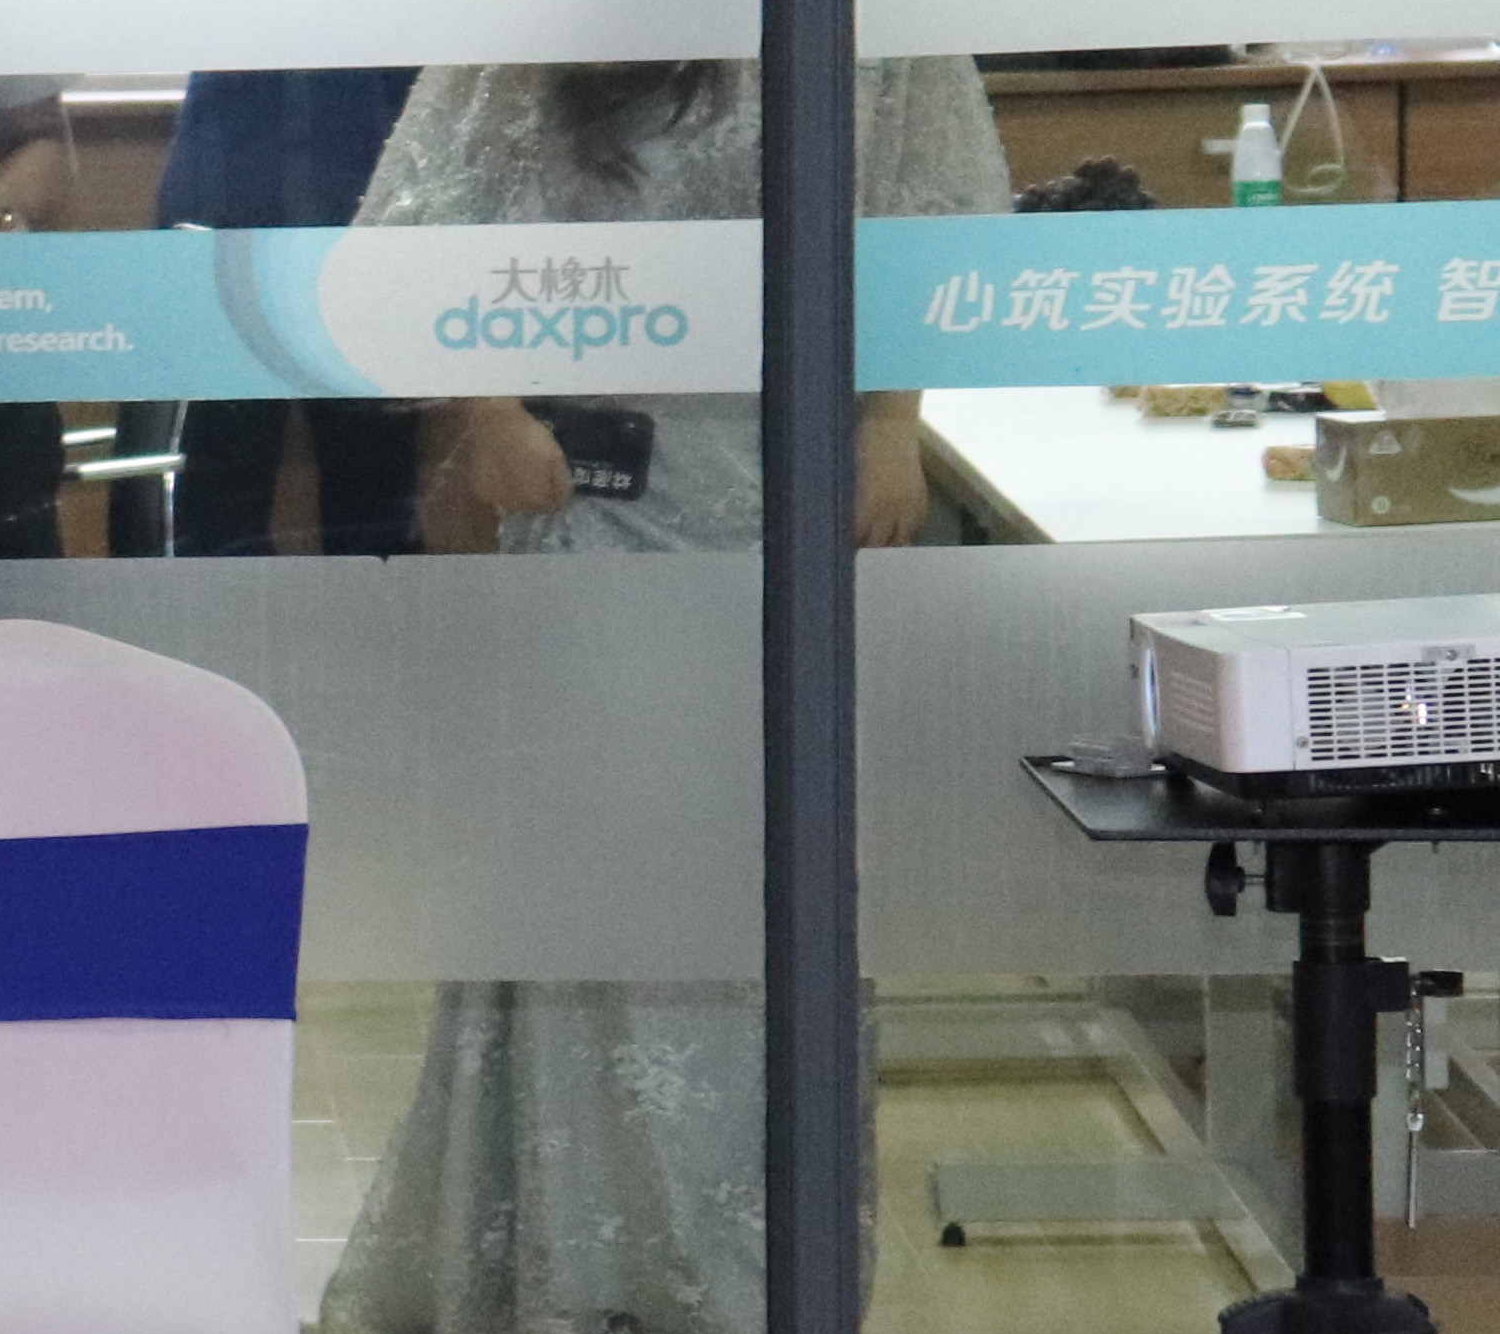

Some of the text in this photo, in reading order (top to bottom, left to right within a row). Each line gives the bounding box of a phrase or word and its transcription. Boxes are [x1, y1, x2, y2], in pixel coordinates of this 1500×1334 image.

[434, 297, 689, 360] daxpro
[924, 261, 1400, 333] 心筑实验系统
